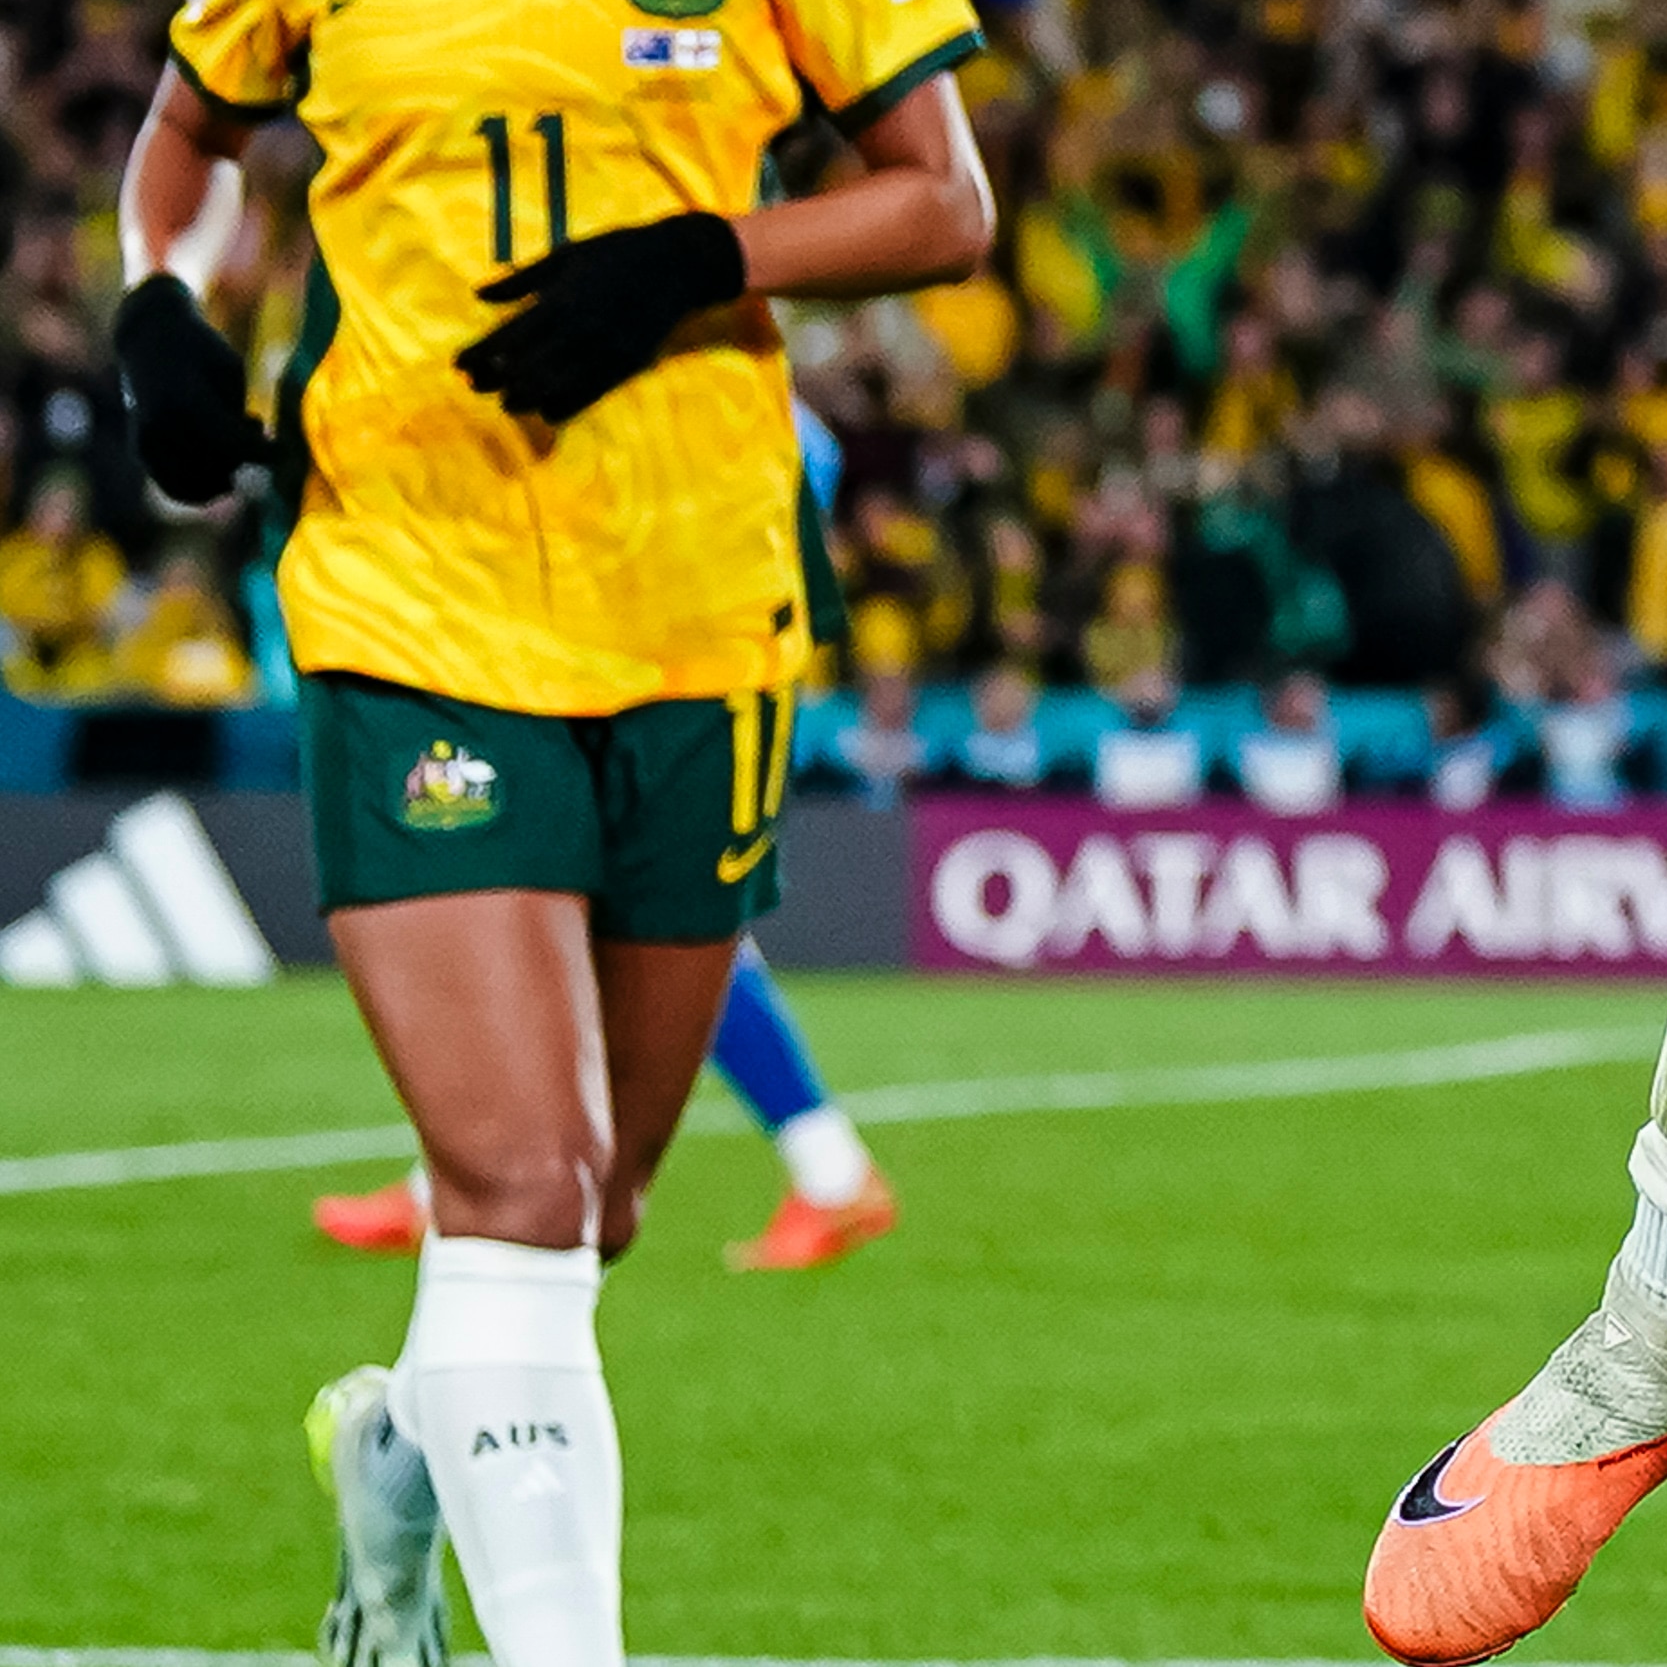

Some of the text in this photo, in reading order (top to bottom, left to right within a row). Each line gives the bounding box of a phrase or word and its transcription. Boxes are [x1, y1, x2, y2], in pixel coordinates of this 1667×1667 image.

[475, 112, 568, 263] 11
[932, 828, 1392, 968] QATAR
[471, 1422, 570, 1457] AUS
